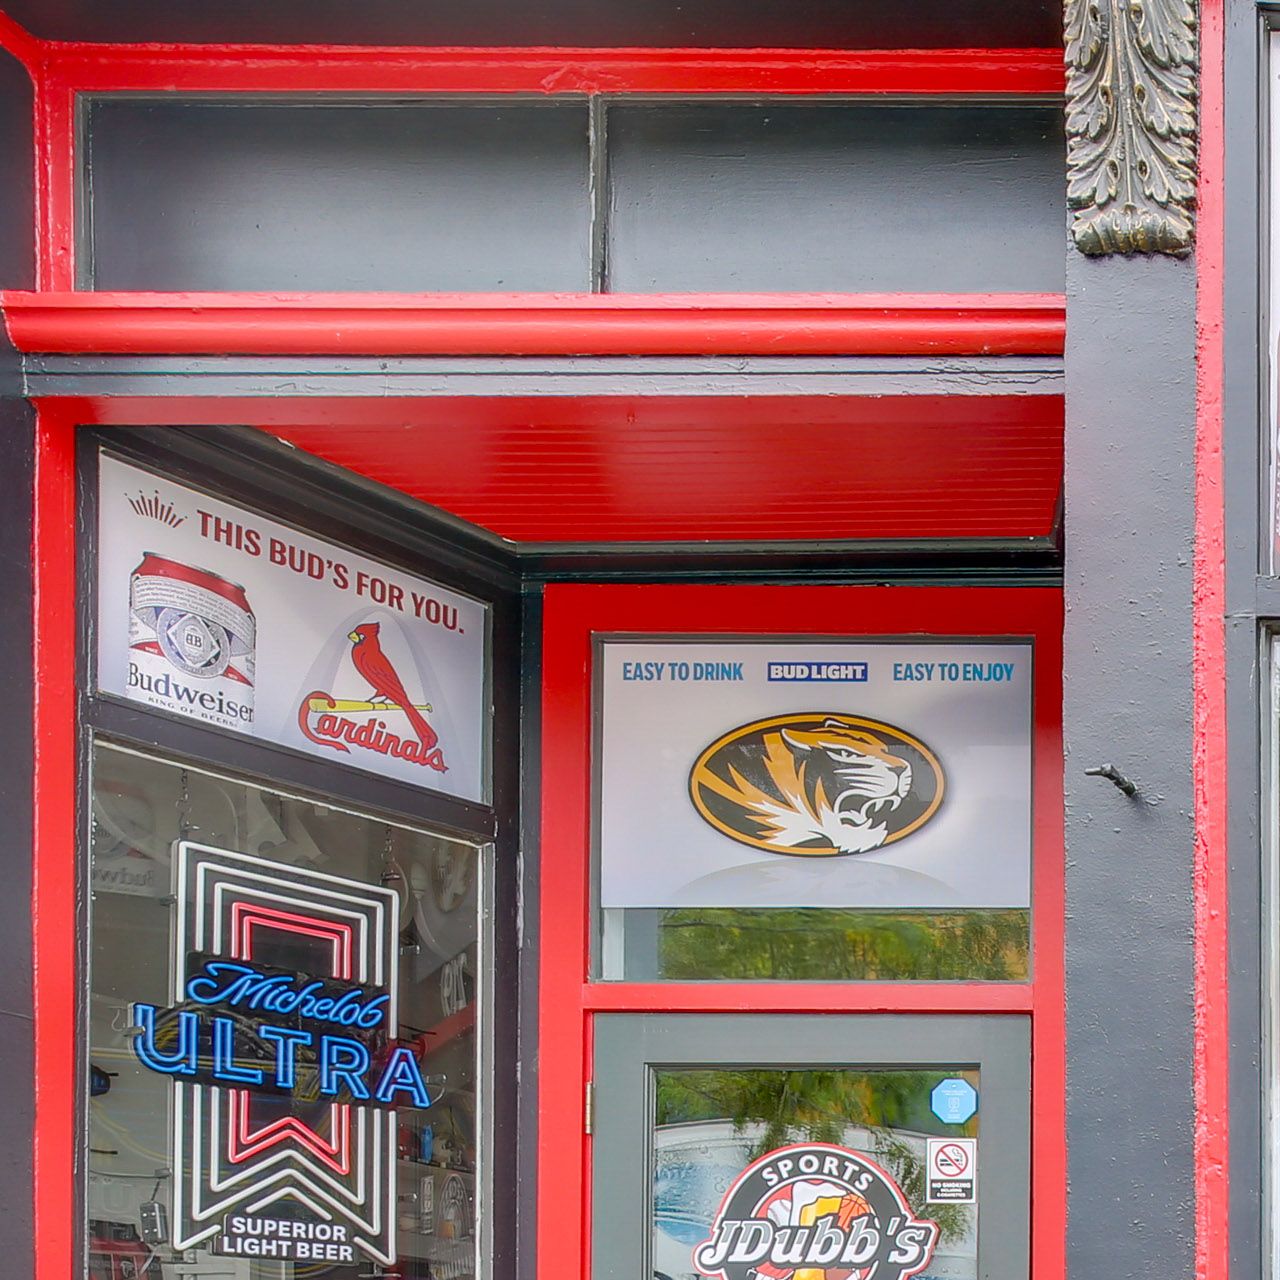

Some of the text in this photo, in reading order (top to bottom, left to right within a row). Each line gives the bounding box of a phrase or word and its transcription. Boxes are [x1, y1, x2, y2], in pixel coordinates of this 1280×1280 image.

[198, 510, 464, 634] THIS BUD'S FOR YOU.
[129, 662, 254, 722] Budweiser
[623, 662, 744, 681] EASY TO DRINK
[770, 665, 865, 679] BUD LIGHT
[893, 663, 1014, 682] EASY TO ENJOY
[298, 690, 449, 774] Cardinals
[187, 962, 390, 1030] Michelob
[133, 1003, 430, 1109] ULTRA
[762, 1154, 873, 1191] SPORTS
[223, 1236, 353, 1261] LIGHT BEER
[231, 1216, 347, 1242] SUPERIOR
[699, 1215, 926, 1266] JDubb's
